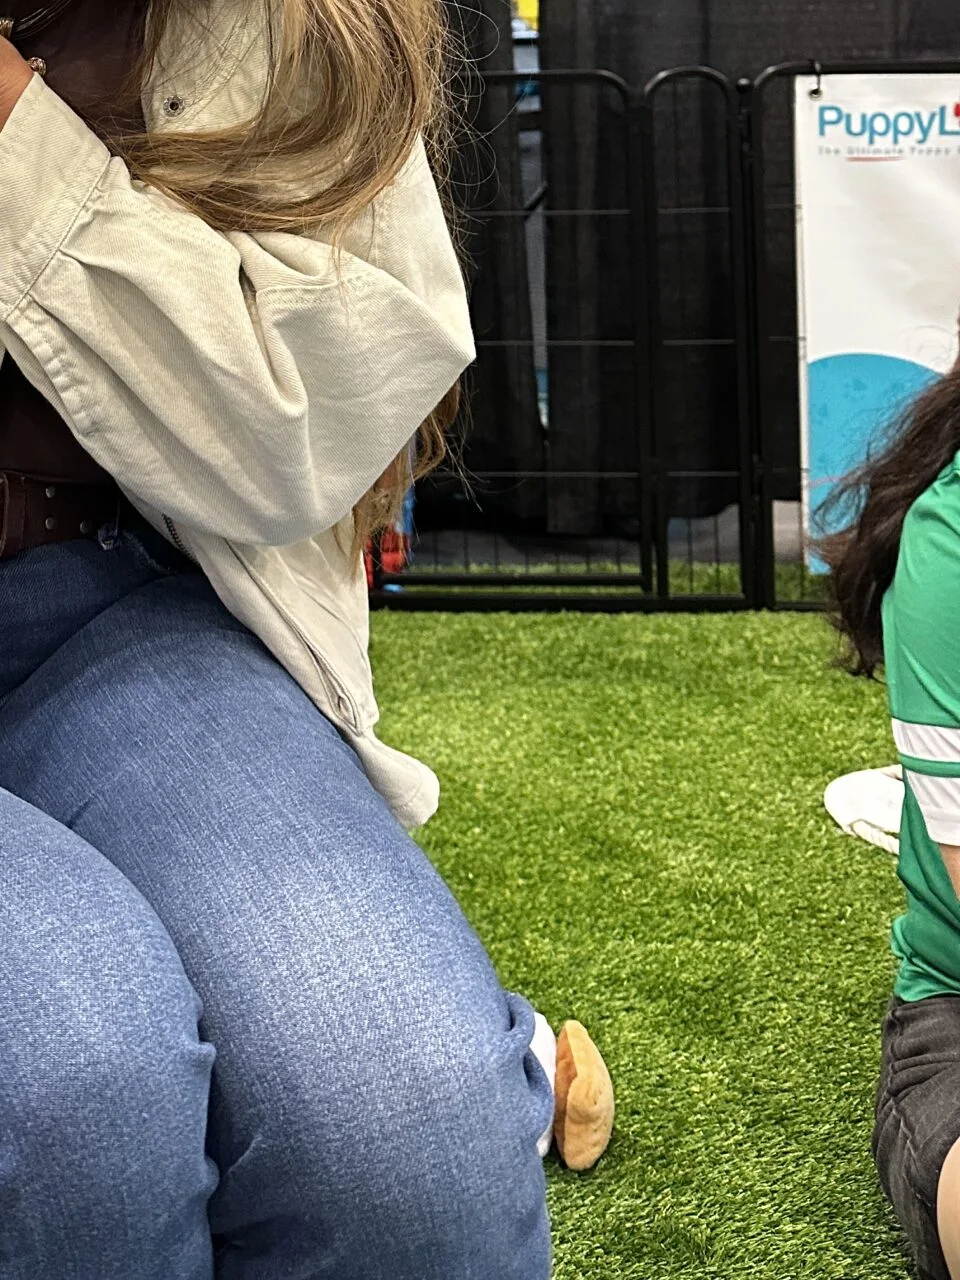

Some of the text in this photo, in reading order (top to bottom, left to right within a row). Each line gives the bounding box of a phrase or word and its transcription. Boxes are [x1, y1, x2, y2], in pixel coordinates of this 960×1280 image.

[818, 104, 960, 145] PuppyL
[818, 146, 840, 155] The
[847, 146, 904, 155] Ultimate
